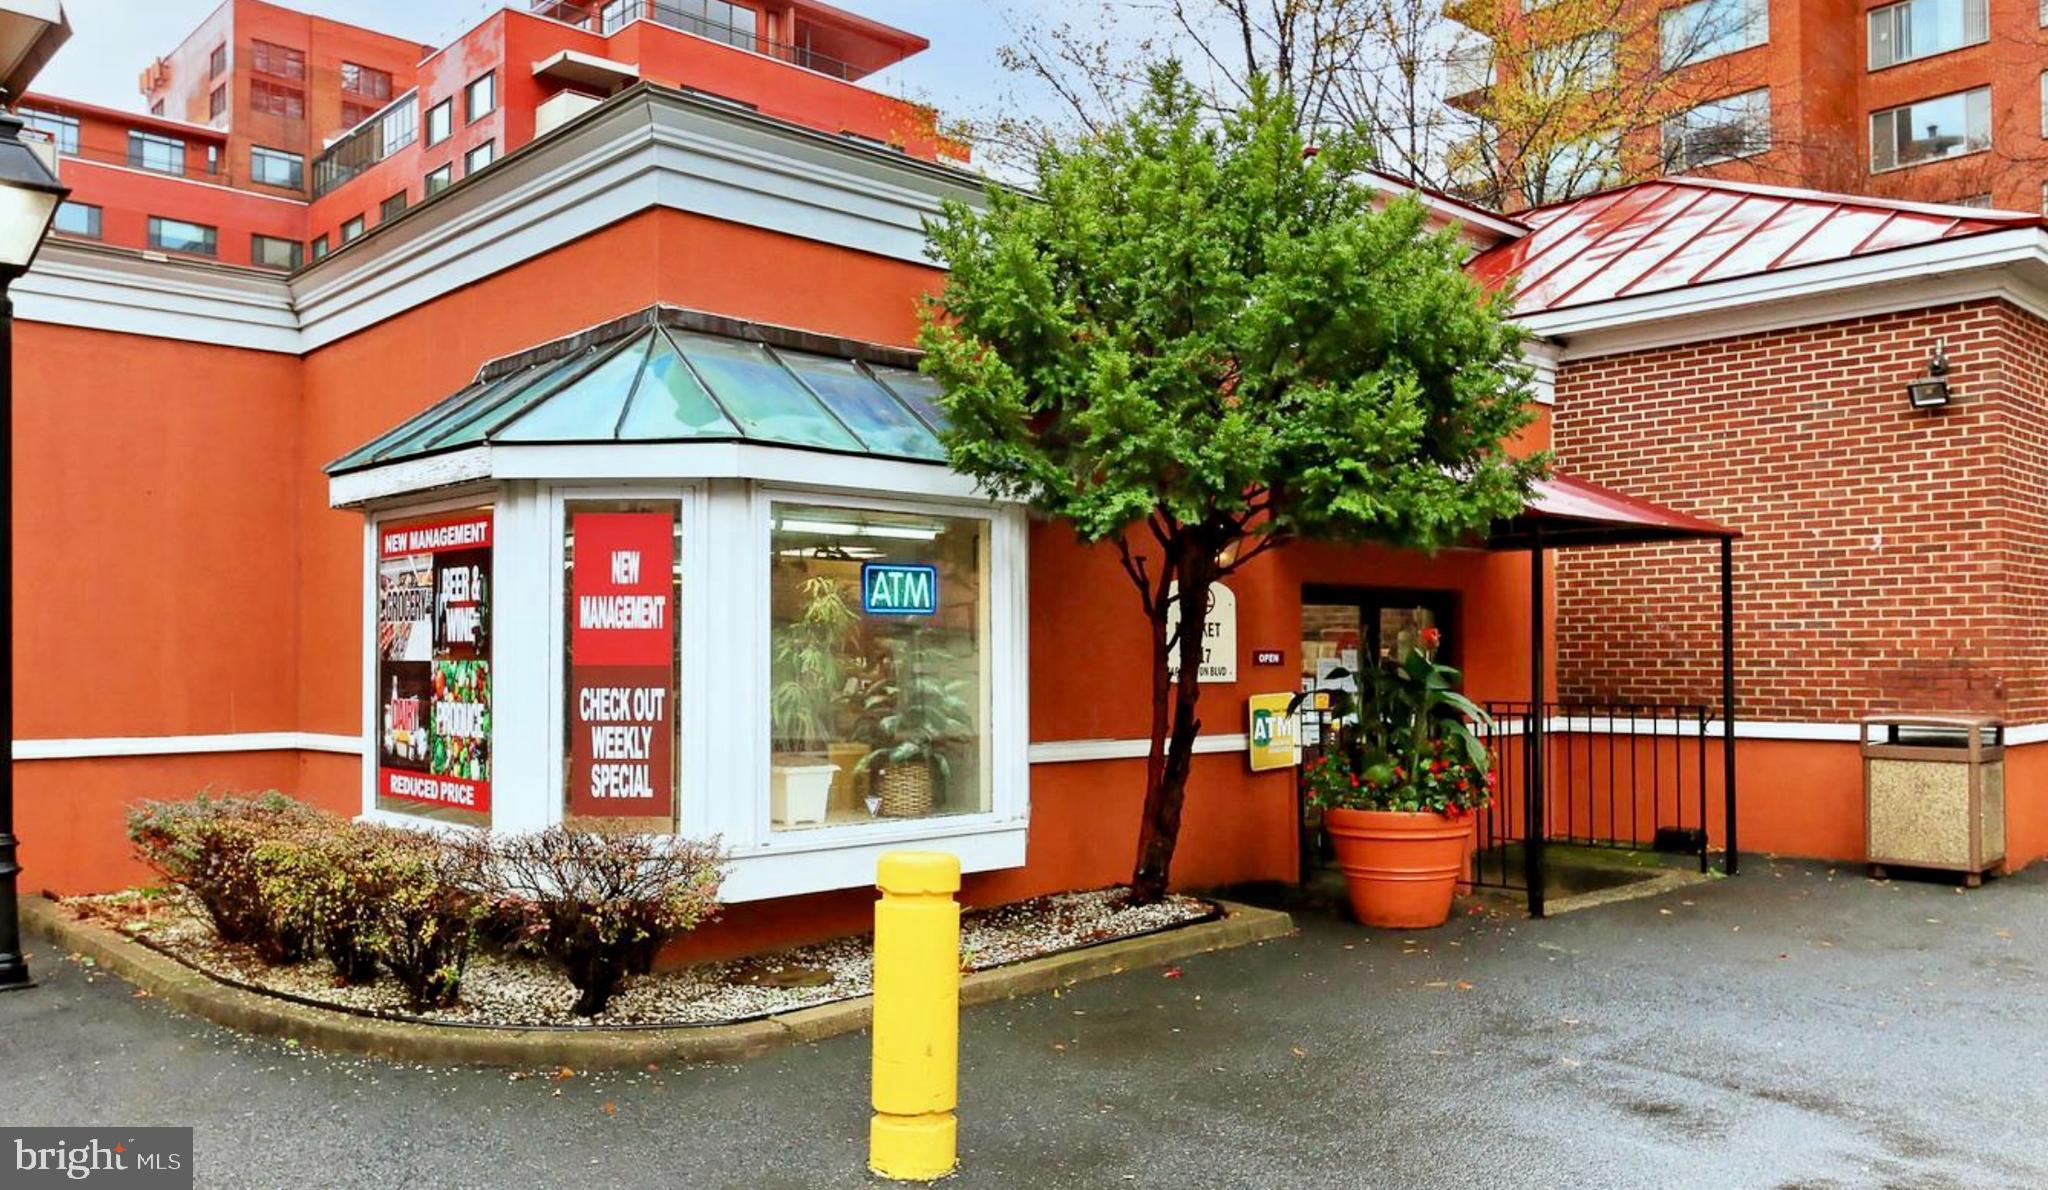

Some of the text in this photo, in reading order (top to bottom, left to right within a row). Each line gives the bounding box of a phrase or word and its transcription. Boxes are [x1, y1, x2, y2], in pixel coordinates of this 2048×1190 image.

[385, 521, 487, 553] NEW MANAGEMENT
[442, 565, 481, 601] BEER &
[611, 551, 640, 585] NEW
[385, 590, 427, 621] GROCERY
[870, 571, 930, 608] ATM
[580, 595, 666, 629] MANAGEMENT
[1210, 666, 1228, 677] BLVD
[1258, 653, 1280, 664] OPEN
[580, 687, 665, 721] CHECK OUT
[591, 726, 653, 759] WEEKLY
[1254, 716, 1292, 741] ATM
[390, 774, 475, 805] REDUCED PRICE
[591, 763, 653, 798] SPECIAL
